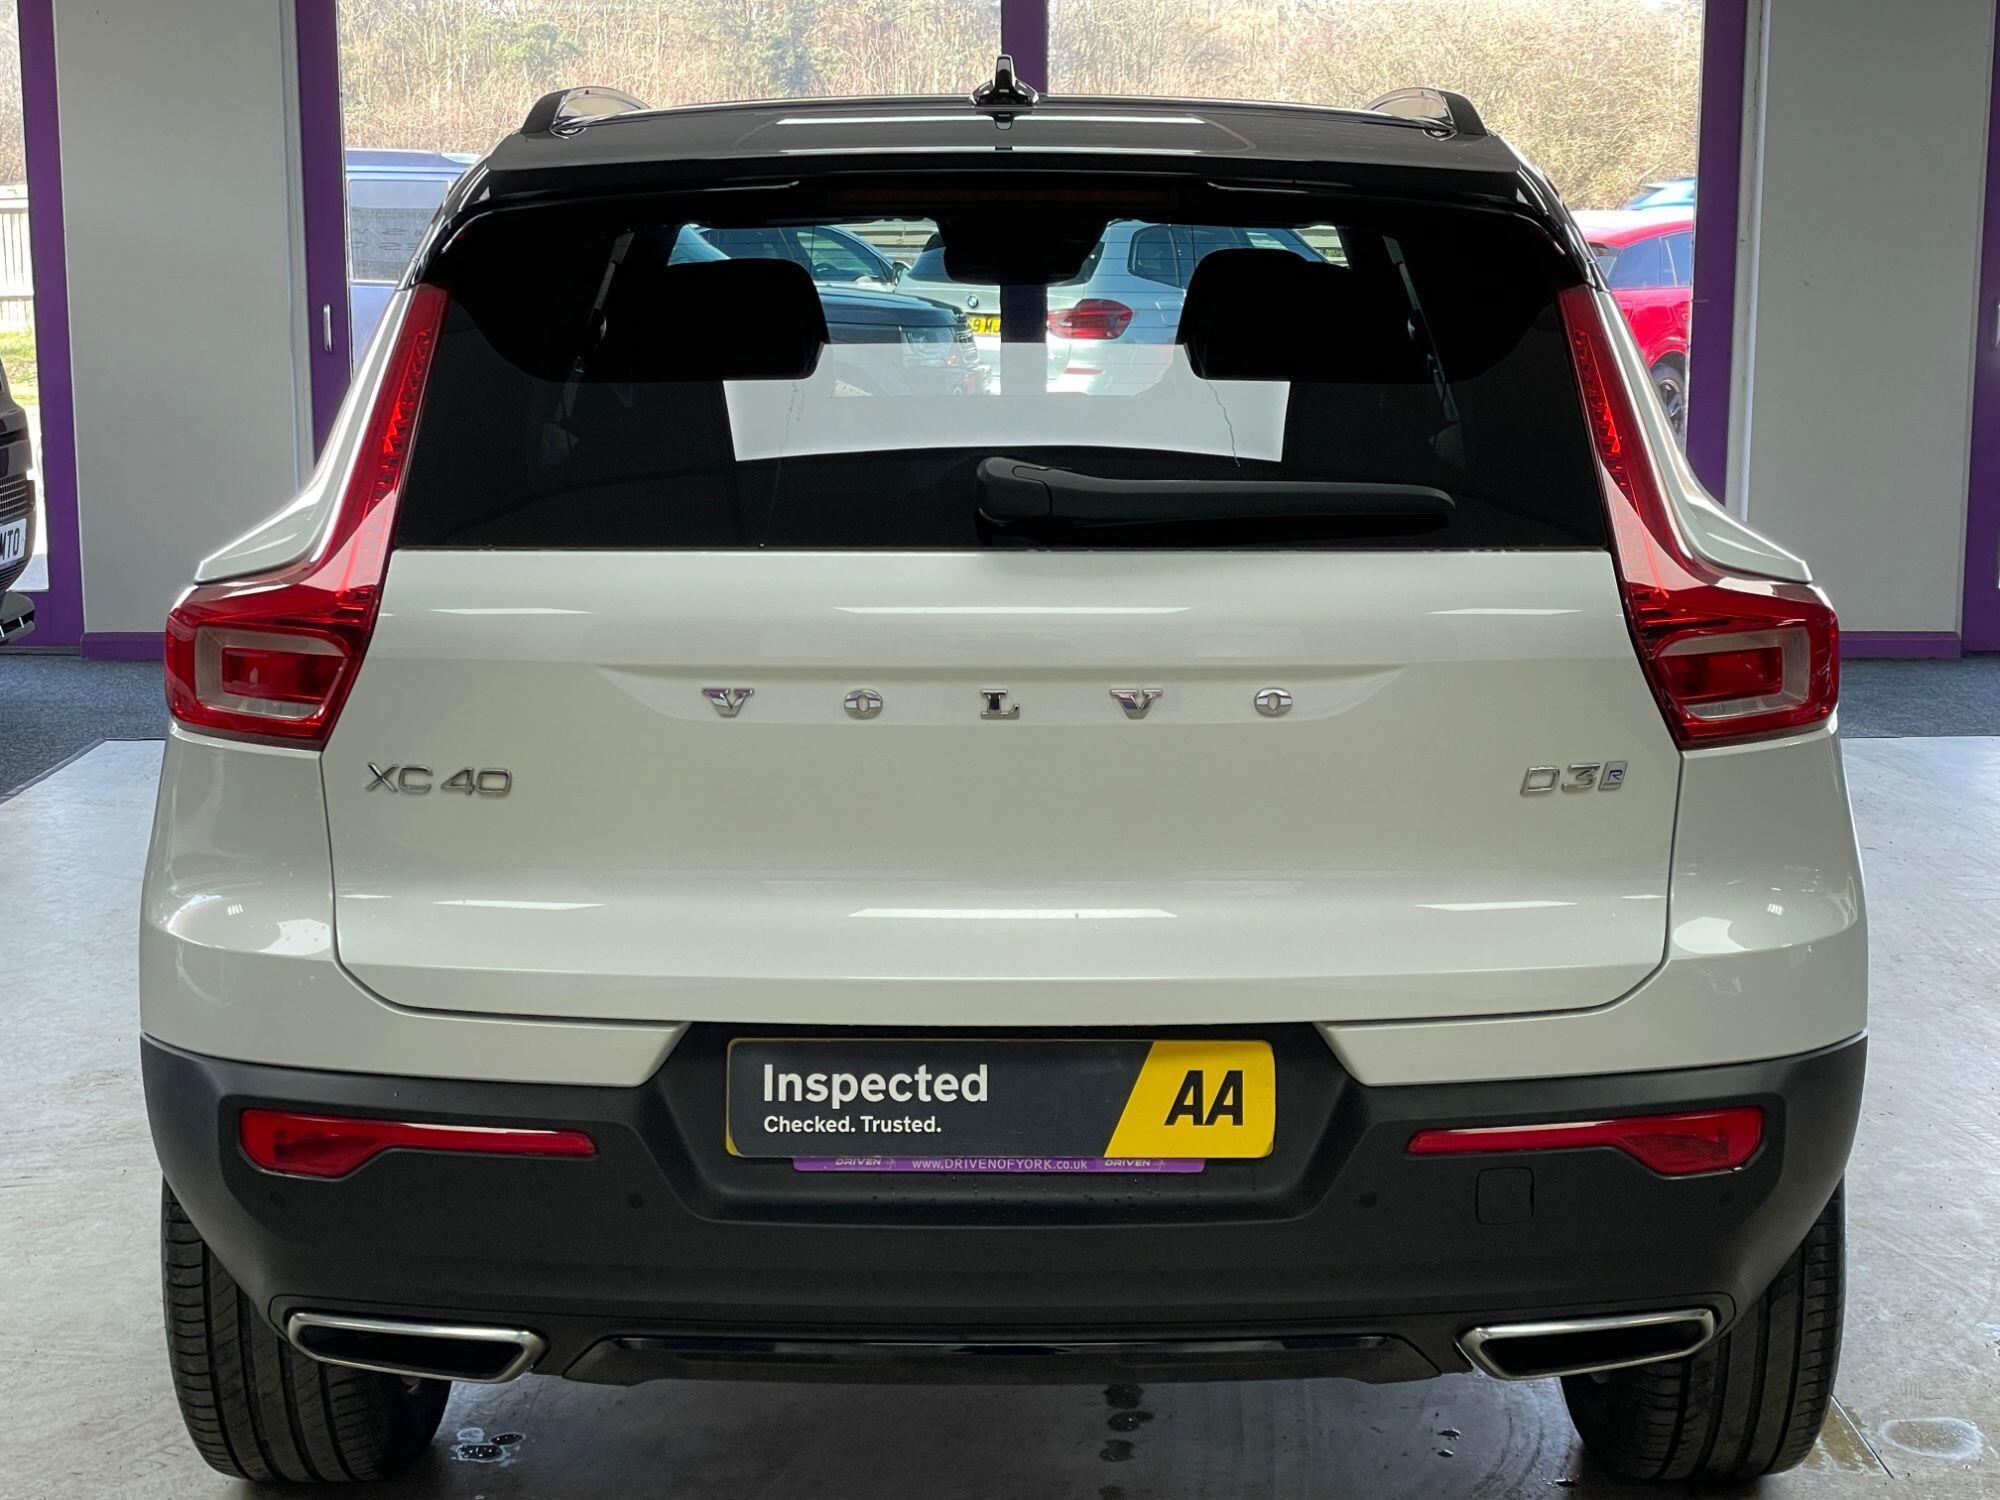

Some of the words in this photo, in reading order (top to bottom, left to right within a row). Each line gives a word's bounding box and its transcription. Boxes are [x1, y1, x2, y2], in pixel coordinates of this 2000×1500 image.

[702, 688, 1293, 720] VOLVO
[763, 1063, 989, 1110] Inspected
[1163, 1069, 1244, 1127] AA
[763, 1115, 856, 1133] Checked.
[860, 1115, 942, 1133] Trusted.
[835, 1158, 882, 1167] DRIVEN
[912, 1158, 1088, 1171] www.DRIVENOFYORK.co.uk
[1104, 1158, 1151, 1168] DRIVEN
